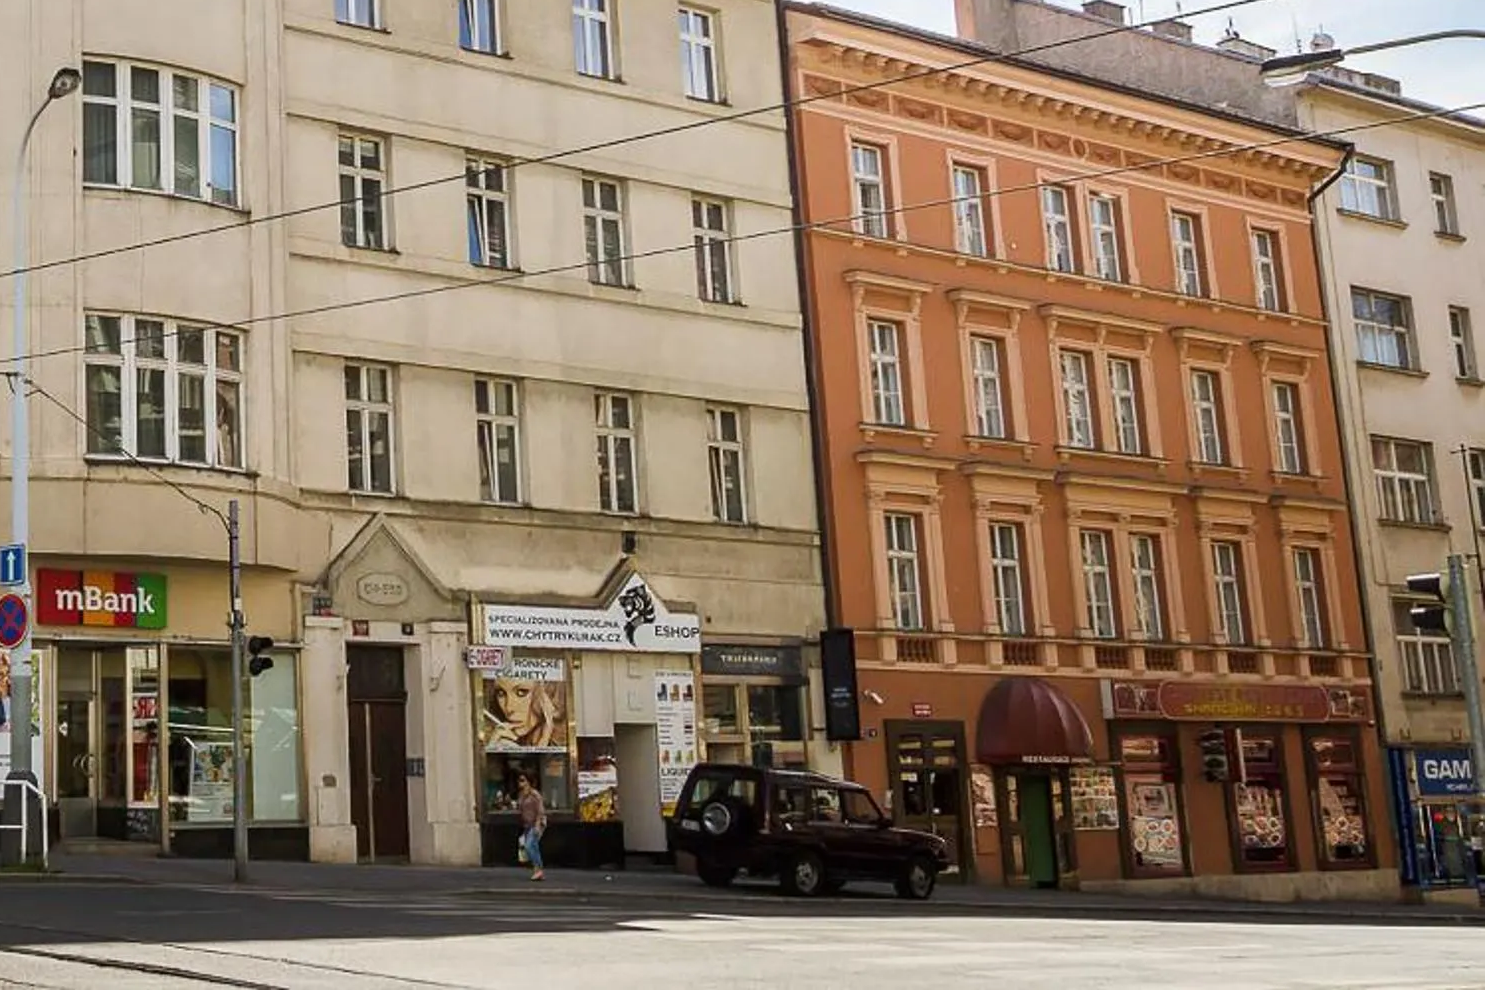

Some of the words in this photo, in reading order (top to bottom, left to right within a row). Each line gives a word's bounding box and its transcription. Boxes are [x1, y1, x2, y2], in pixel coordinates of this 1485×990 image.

[56, 585, 155, 615] mBank
[489, 629, 622, 642] WWW.CHYTRYKURAK.CZ
[655, 625, 699, 639] ESHOP
